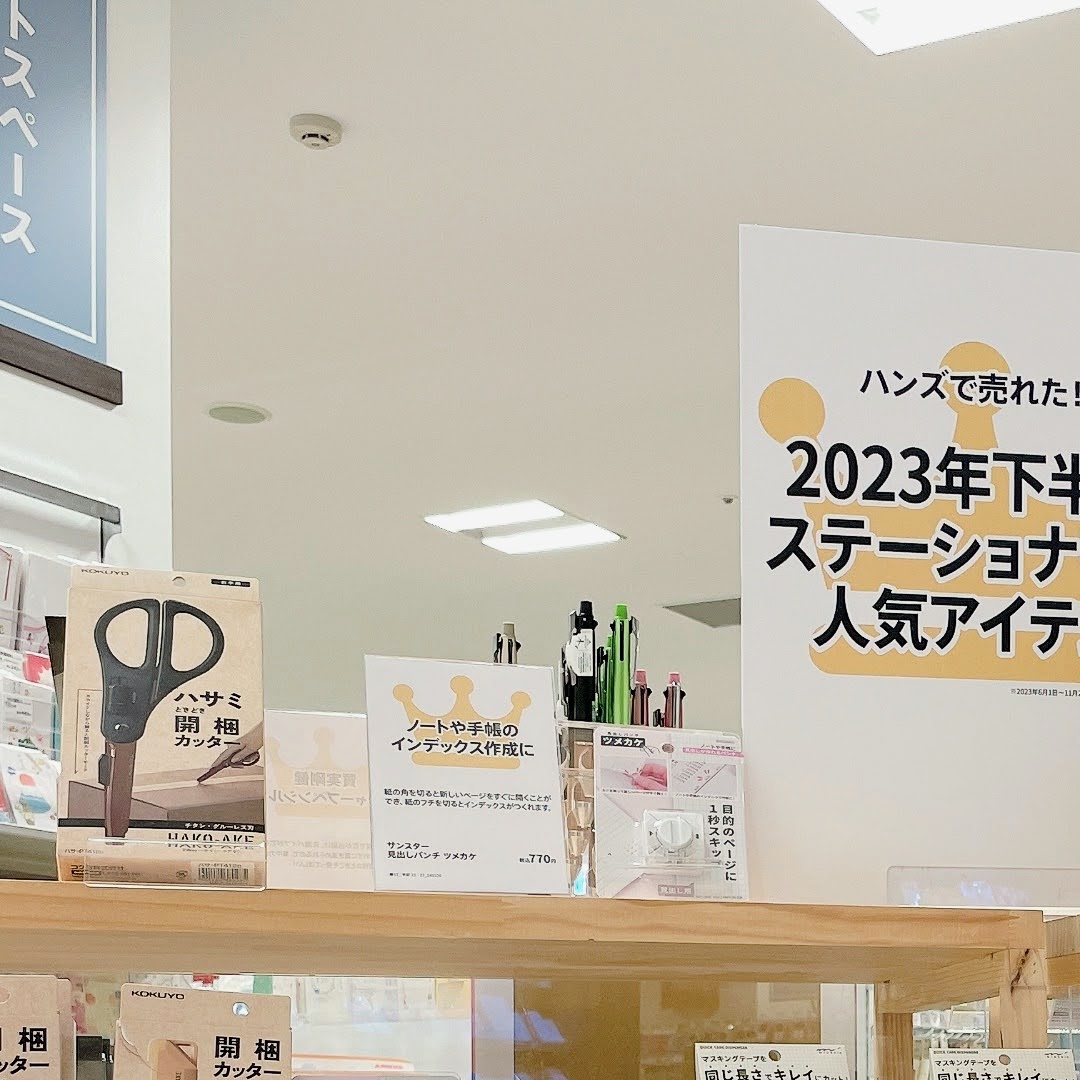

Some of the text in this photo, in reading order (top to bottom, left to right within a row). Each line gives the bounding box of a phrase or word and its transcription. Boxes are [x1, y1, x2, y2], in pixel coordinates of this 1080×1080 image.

[174, 691, 242, 710] ハサミ
[175, 706, 205, 714] ときどき
[407, 720, 519, 738] ノートや手帳の
[174, 735, 241, 748] カッター
[391, 737, 535, 757] インデックス作成に
[602, 736, 645, 748] ツメカケ
[387, 842, 429, 850] サンスター
[722, 804, 738, 882] 目的のページに
[387, 851, 477, 861] 見出しパンチ ツメカケ
[519, 854, 557, 864] 税込770円
[131, 990, 185, 1000] KOKUYO
[214, 1037, 281, 1061] 開梱
[701, 1055, 767, 1063] マスキングテープを
[935, 1059, 997, 1067] マスキングテープを
[214, 1061, 282, 1079] カッター
